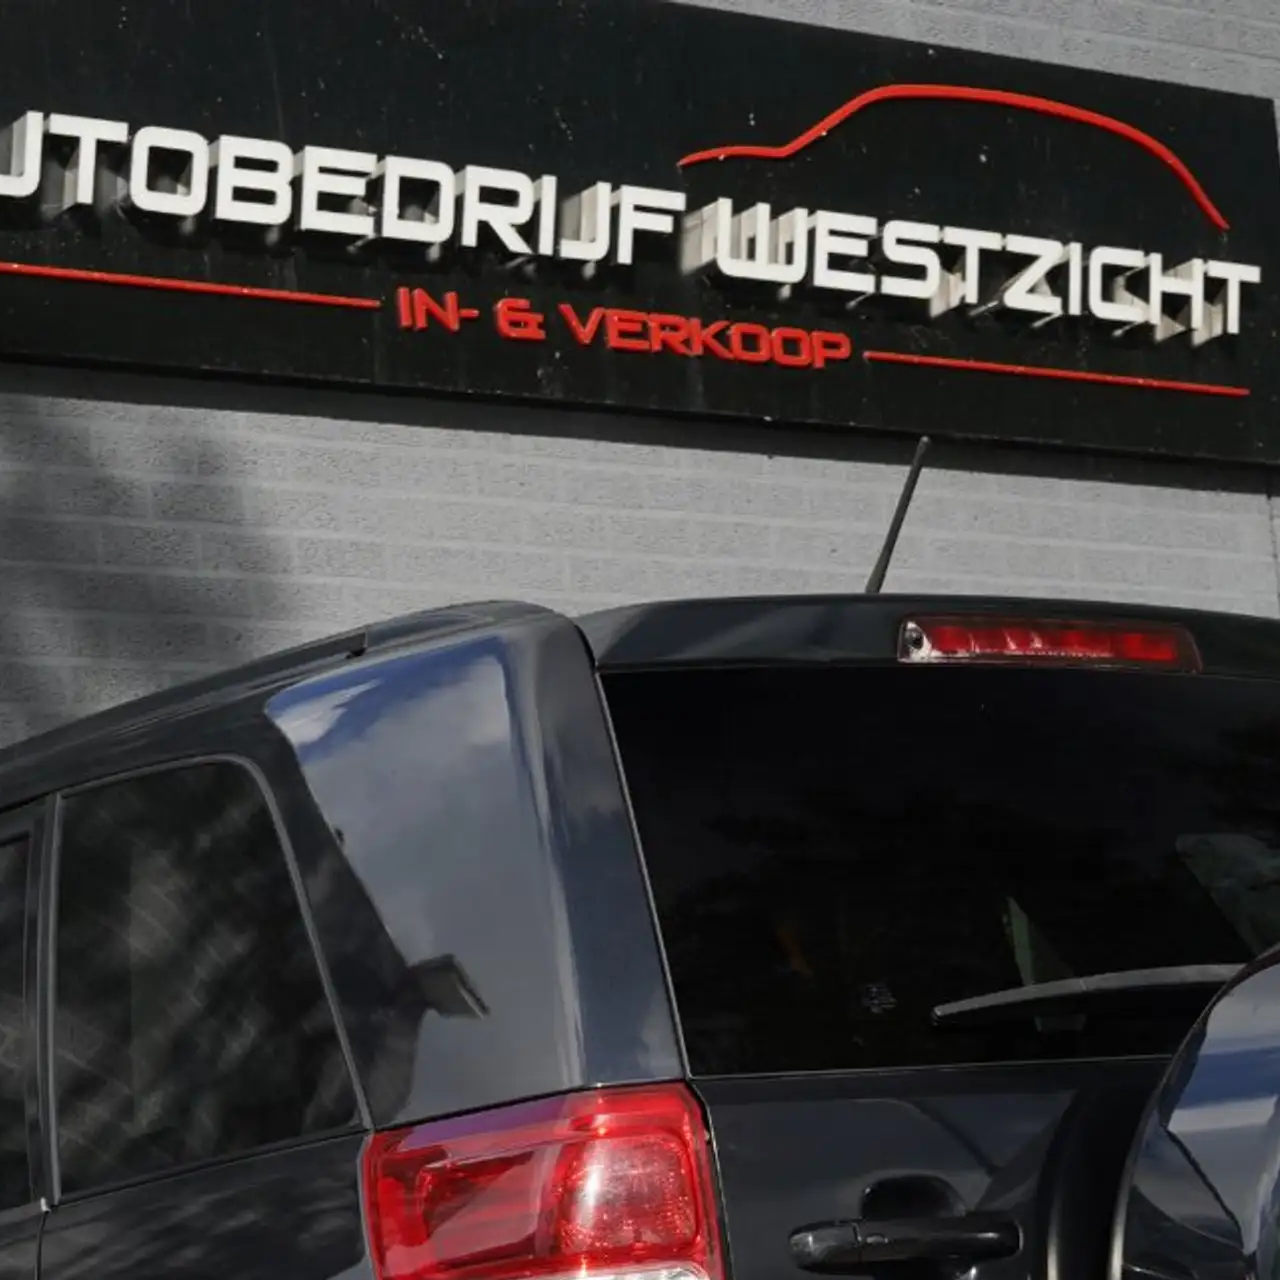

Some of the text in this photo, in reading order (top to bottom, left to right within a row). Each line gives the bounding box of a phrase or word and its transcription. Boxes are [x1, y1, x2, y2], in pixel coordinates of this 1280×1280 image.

[716, 197, 1261, 335] WESTZICHT
[396, 286, 852, 369] IN- & VERKOOP
